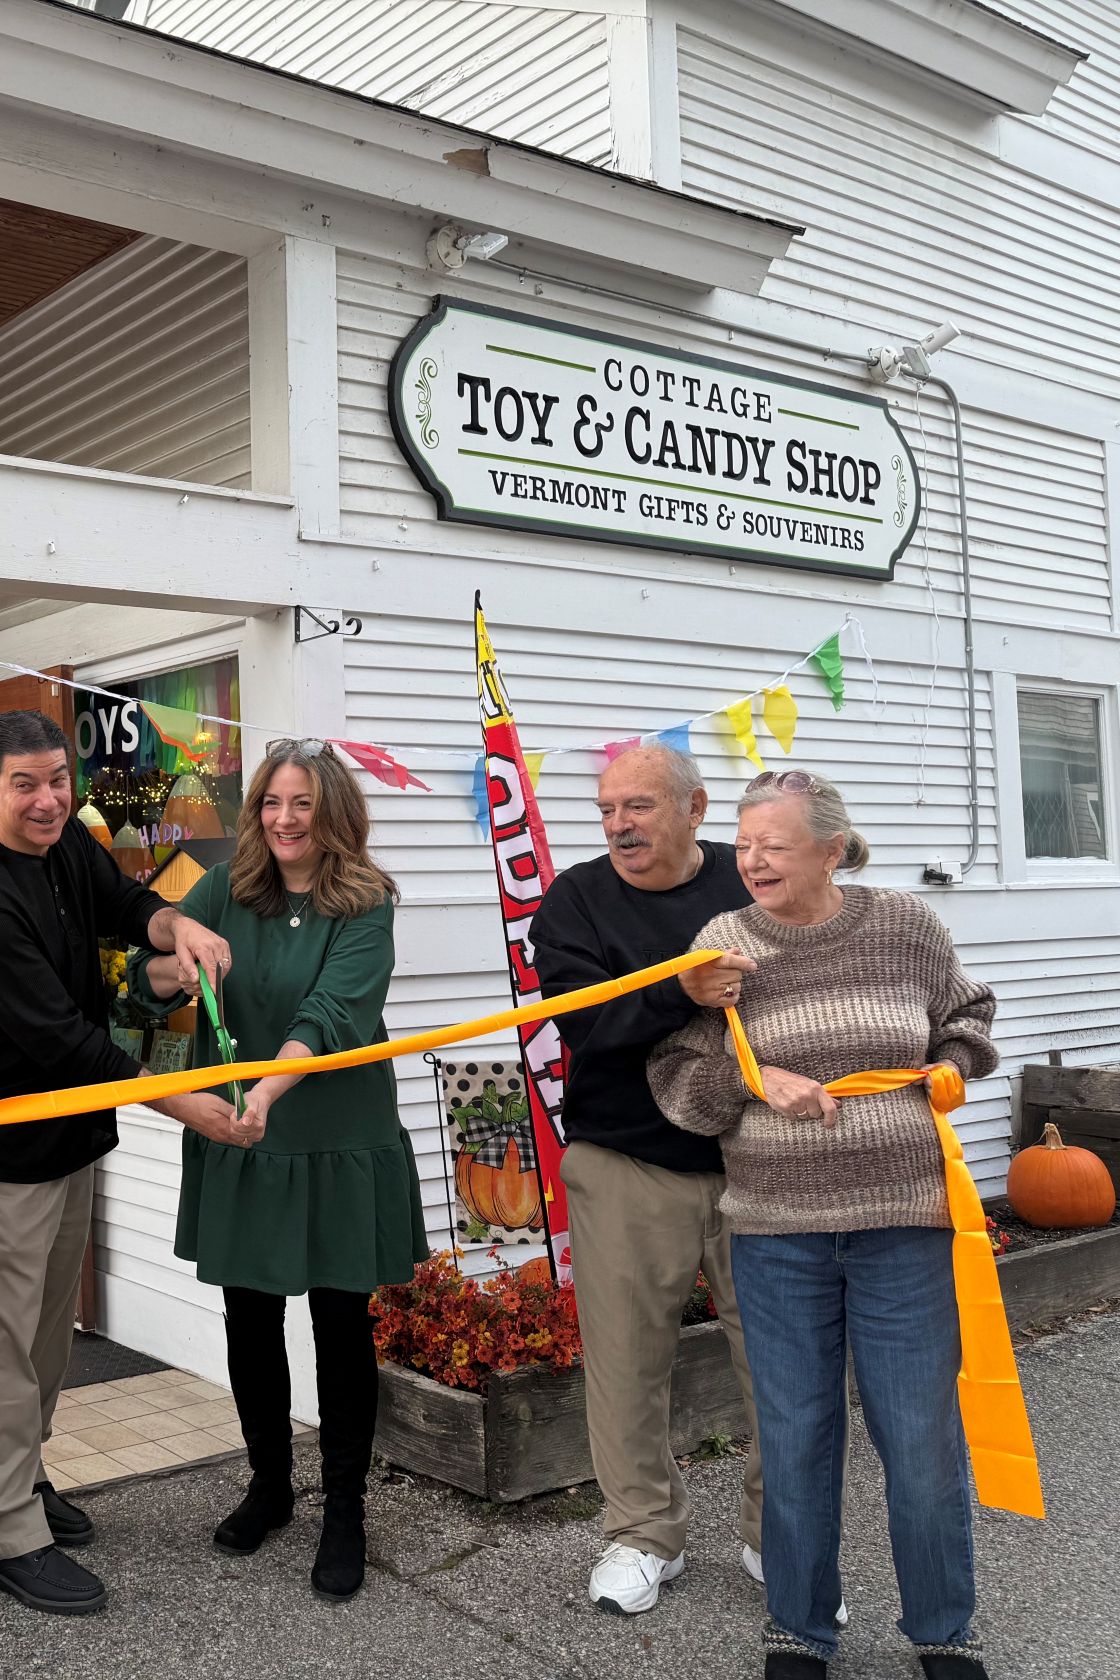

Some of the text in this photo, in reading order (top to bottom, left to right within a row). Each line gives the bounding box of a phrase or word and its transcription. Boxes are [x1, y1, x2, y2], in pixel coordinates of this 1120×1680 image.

[604, 358, 773, 424] COTTAGE
[457, 372, 882, 505] TOY & CANDY SHOP
[488, 470, 865, 552] VERMONT GIFTS & SOUVENIRS
[75, 701, 140, 760] OYS
